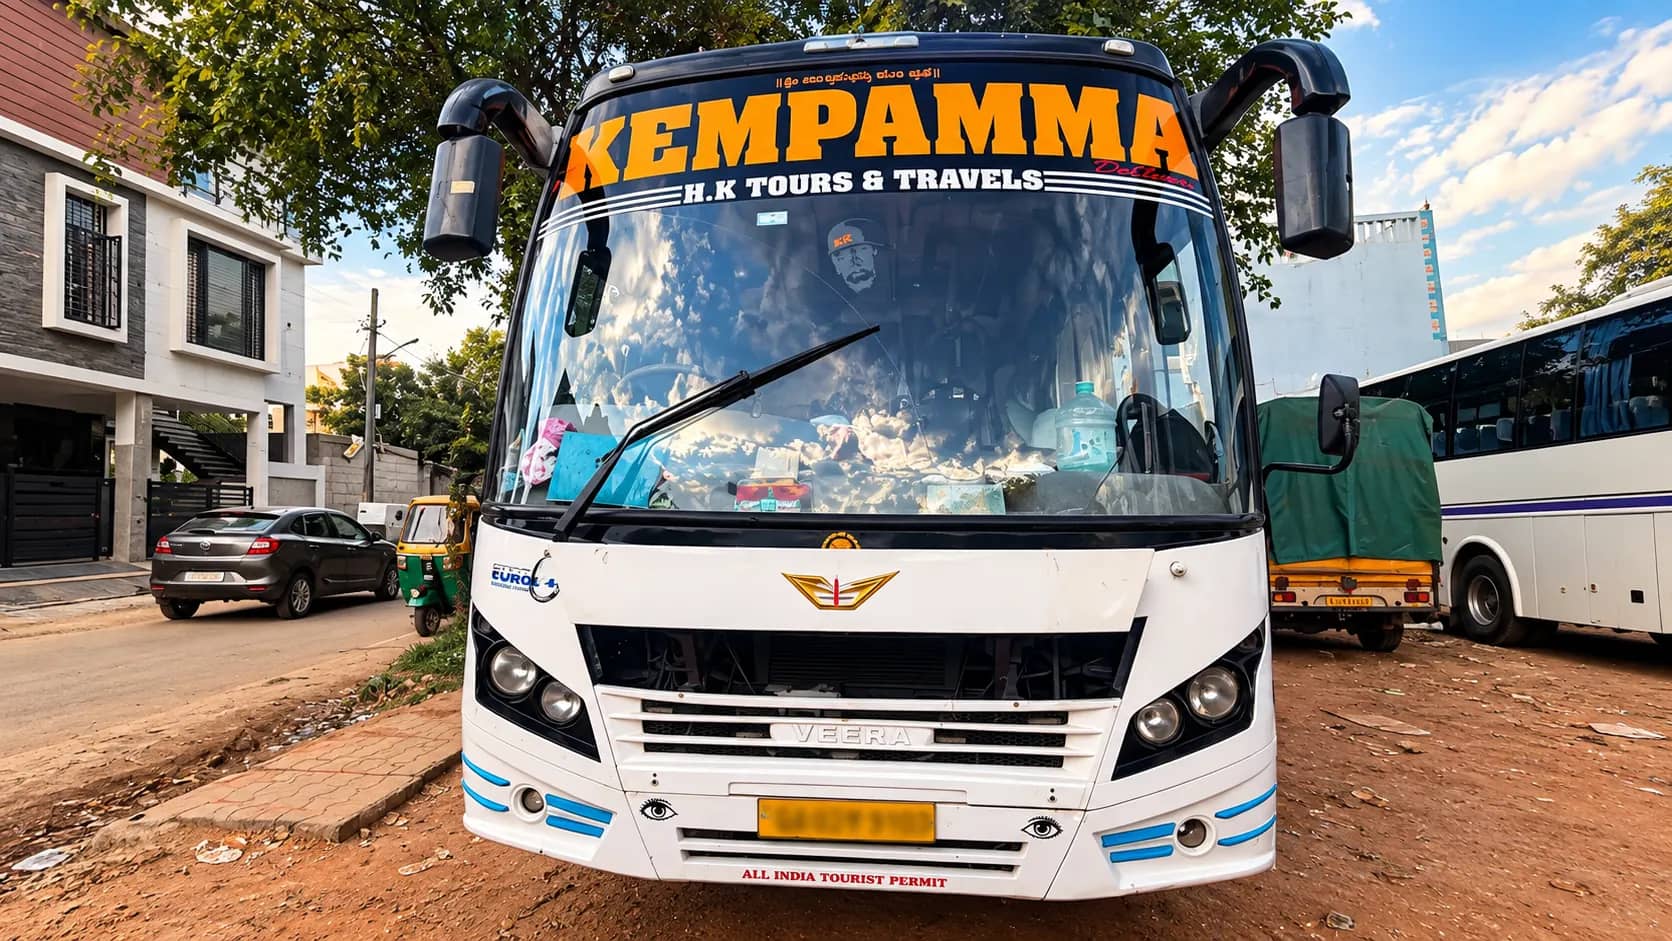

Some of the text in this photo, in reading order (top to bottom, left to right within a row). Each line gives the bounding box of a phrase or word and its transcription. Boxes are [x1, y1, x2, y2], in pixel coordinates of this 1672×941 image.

[560, 83, 1199, 199] KEMPAMMA
[683, 168, 1044, 204] H.K TOURS & TRAVELS
[792, 724, 911, 746] VEERA
[742, 869, 947, 888] ALL INDIA TOURIST PERMIT
